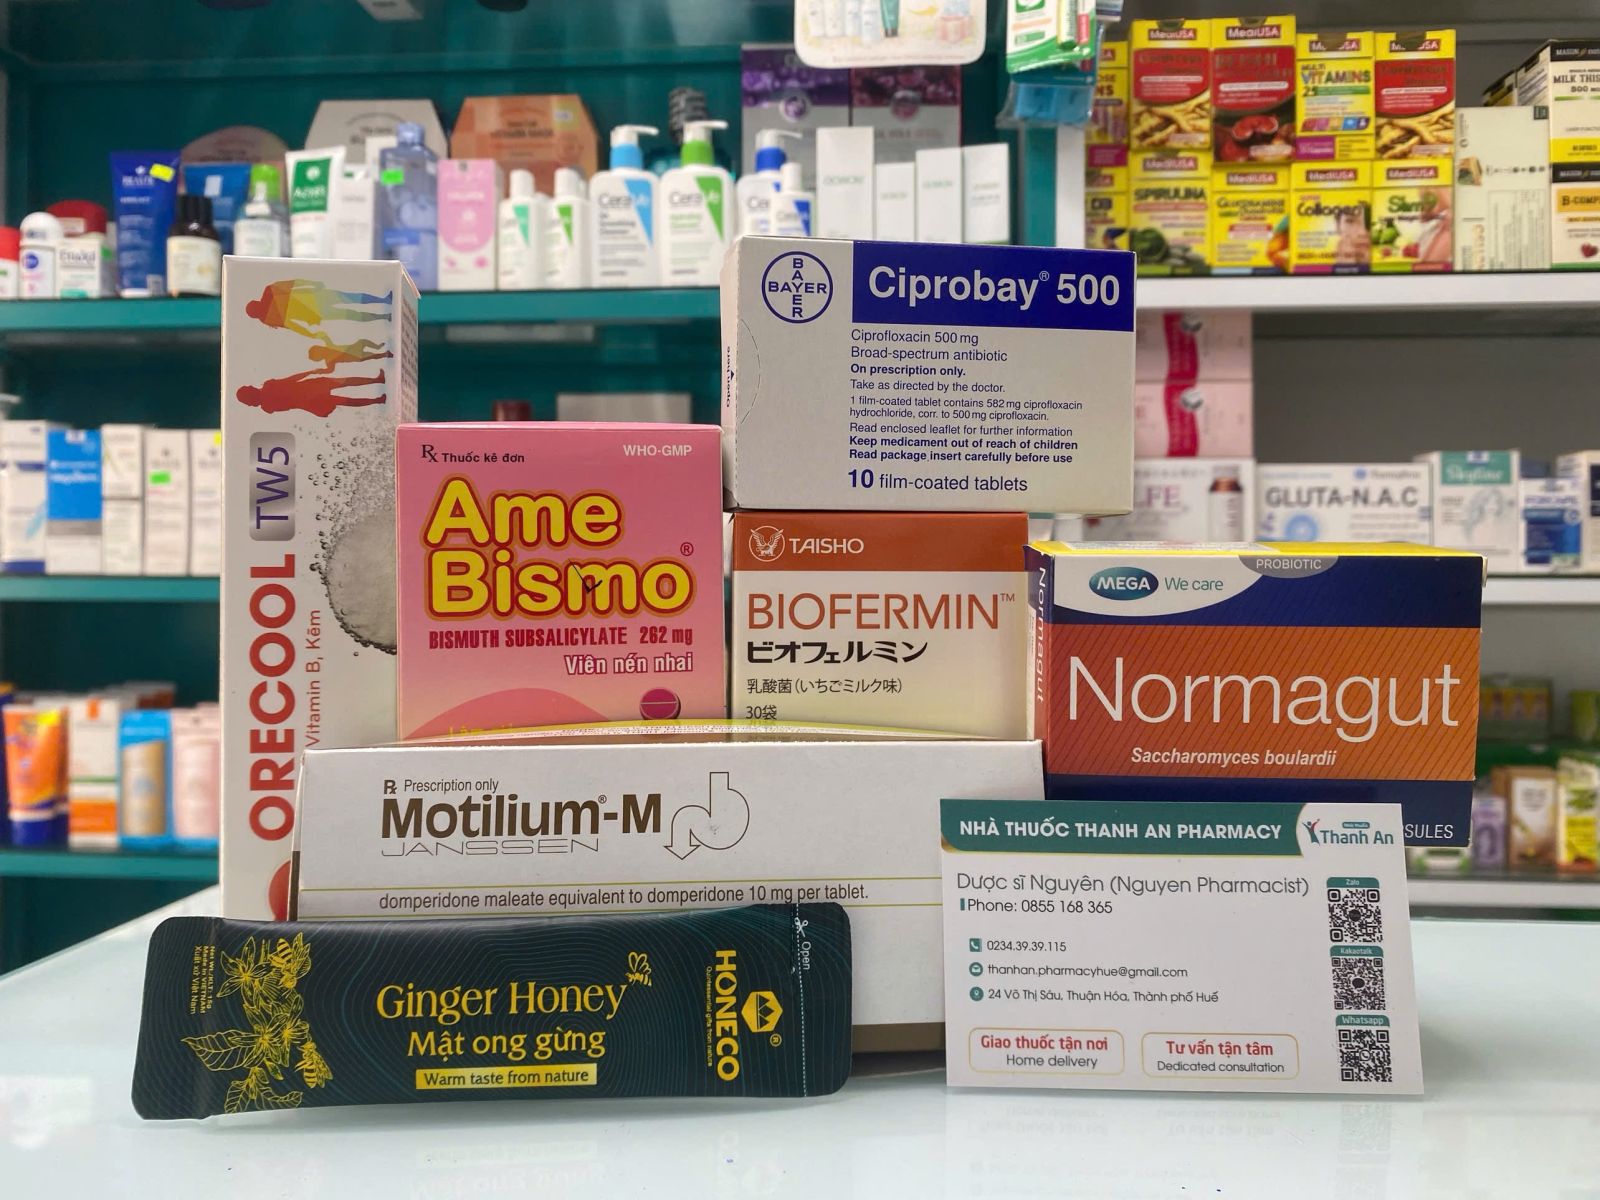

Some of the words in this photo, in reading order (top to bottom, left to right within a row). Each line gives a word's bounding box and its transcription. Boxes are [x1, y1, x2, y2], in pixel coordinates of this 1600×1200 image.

[1302, 70, 1370, 84] VITAMINS
[1554, 75, 1577, 83] MILK
[1579, 74, 1600, 83] THIS
[1135, 188, 1205, 200] SPIRULINA
[1562, 195, 1600, 205] B-COMP
[768, 281, 827, 294] BAYER
[792, 258, 803, 318] BAYER
[1056, 274, 1120, 305] 500
[851, 330, 930, 345] Ciprofloxacin
[935, 332, 957, 343] 500
[960, 335, 979, 346] mg
[851, 346, 949, 361] Broad-spectrum
[953, 349, 1008, 361] antibiotic
[850, 364, 867, 374] On
[870, 365, 937, 377] prescription
[939, 366, 966, 377] only.
[850, 379, 875, 390] Take
[878, 382, 890, 390] as
[893, 380, 934, 391] directed
[937, 381, 949, 393] by
[952, 382, 968, 392] the
[971, 382, 1005, 393] doctor.
[850, 396, 855, 405] 1
[858, 396, 912, 406] film-coated
[914, 397, 941, 407] tablet
[943, 398, 984, 408] contains
[986, 399, 1005, 408] 582
[1006, 401, 1021, 411] mg
[1023, 399, 1083, 411] ciprofloxacin
[850, 422, 877, 433] Read
[880, 423, 927, 434] enclosed
[929, 424, 961, 435] leaflet
[963, 424, 977, 435] for
[979, 425, 1013, 436] further
[1016, 426, 1073, 437] information
[623, 445, 692, 457] WHO-GMP
[849, 436, 877, 447] Keep
[880, 437, 948, 448] medicament
[950, 439, 969, 448] out
[972, 438, 983, 448] of
[986, 439, 1017, 449] reach
[1019, 439, 1031, 449] of
[1033, 440, 1078, 450] children
[442, 451, 480, 463] Thuốc
[502, 453, 525, 463] đơn
[849, 449, 877, 460] Read
[880, 450, 927, 462] package
[930, 451, 961, 461] insert
[964, 451, 1012, 463] carefully
[1015, 452, 1050, 463] before
[1053, 454, 1073, 463] use
[256, 446, 290, 530] TW5
[848, 469, 874, 488] 10
[879, 473, 969, 490] film-coated
[974, 476, 1028, 491] tablets
[1265, 486, 1419, 508] GLUTA-N.A.C
[422, 476, 622, 549] Ame
[789, 538, 865, 554] TAISHO
[1256, 559, 1322, 570] PROBIOTIC
[428, 547, 694, 618] Bismo
[1096, 577, 1151, 591] MEGA
[1164, 577, 1189, 591] We
[1192, 579, 1224, 592] care
[305, 609, 321, 649] Kẽm
[1036, 567, 1046, 703] Normagut
[429, 629, 499, 649] BISMUTH
[505, 626, 627, 647] SUBSALICYLATE
[640, 626, 667, 644] 262
[672, 628, 693, 645] mg
[747, 641, 928, 664] ビオフェルミン
[564, 654, 607, 675] Viên
[614, 652, 648, 673] nén
[654, 652, 693, 672] nhai
[249, 553, 296, 841] ORECOOL
[1069, 656, 1460, 743] Normagut
[305, 680, 321, 747] Vitamin
[745, 705, 778, 721] 30袋
[1131, 747, 1260, 767] Saccharomyces
[1264, 749, 1336, 766] boulardii
[404, 779, 472, 796] Prescription
[475, 778, 499, 794] only
[959, 818, 999, 836] NHÀ
[1005, 817, 1069, 837] THUỐC
[1075, 823, 1137, 838] THANH
[1145, 824, 1170, 838] AN
[1178, 825, 1281, 840] PHARMACY
[1404, 824, 1454, 839] SULES
[1320, 830, 1368, 844] Thanh
[1373, 831, 1394, 844] An
[381, 838, 598, 857] JANSSEN
[957, 873, 1008, 893] Dược
[1012, 873, 1026, 890] sĩ
[1030, 874, 1104, 895] Nguyên
[1110, 876, 1191, 897] (Nguyen
[1197, 877, 1310, 897] Pharmacist)
[379, 890, 480, 912] domperidone
[484, 889, 546, 908] maleate
[548, 887, 625, 908] equivalent
[629, 888, 643, 904] to
[647, 886, 744, 907] domperidone
[749, 885, 766, 901] 10
[771, 888, 793, 904] mg
[798, 886, 821, 904] per
[824, 883, 869, 899] tablet.
[967, 898, 1018, 913] Phone:
[1021, 899, 1055, 913] 0855
[1060, 900, 1083, 913] 168
[1088, 900, 1113, 914] 365
[987, 940, 1067, 952] 0234.39.39.115
[801, 941, 811, 970] Open
[988, 964, 1188, 979] thanhan.pharmacyhue@gmail.com
[376, 982, 498, 1025] Ginger
[509, 981, 628, 1021] Honey
[988, 990, 1001, 999] 24
[1004, 989, 1020, 1000] Võ
[1023, 989, 1038, 1002] Thị
[1040, 989, 1063, 1001] Sáu,
[1066, 990, 1101, 1003] Thuận
[1104, 990, 1130, 1002] Hóa,
[1133, 991, 1168, 1002] Thành
[1171, 990, 1194, 1004] phố
[1196, 990, 1219, 1003] Huế
[715, 950, 740, 1081] HONECO
[1341, 1016, 1384, 1026] Whatsapp
[407, 1030, 465, 1062] Mật
[472, 1032, 527, 1061] ong
[533, 1026, 606, 1060] gừng
[981, 1035, 1011, 1049] Giao
[1015, 1033, 1055, 1050] thuốc
[1059, 1037, 1082, 1053] tận
[1086, 1037, 1108, 1050] nơi
[1165, 1040, 1184, 1054] Tư
[1188, 1039, 1215, 1055] vấn
[1218, 1041, 1243, 1058] tận
[1246, 1041, 1273, 1056] tâm
[1006, 1054, 1044, 1067] Home
[1047, 1055, 1098, 1069] delivery
[1157, 1061, 1216, 1072] Dedicated
[1218, 1062, 1284, 1073] consultation
[424, 1072, 465, 1086] Warm
[470, 1071, 504, 1085] taste
[507, 1070, 540, 1085] from
[544, 1070, 589, 1083] nature
